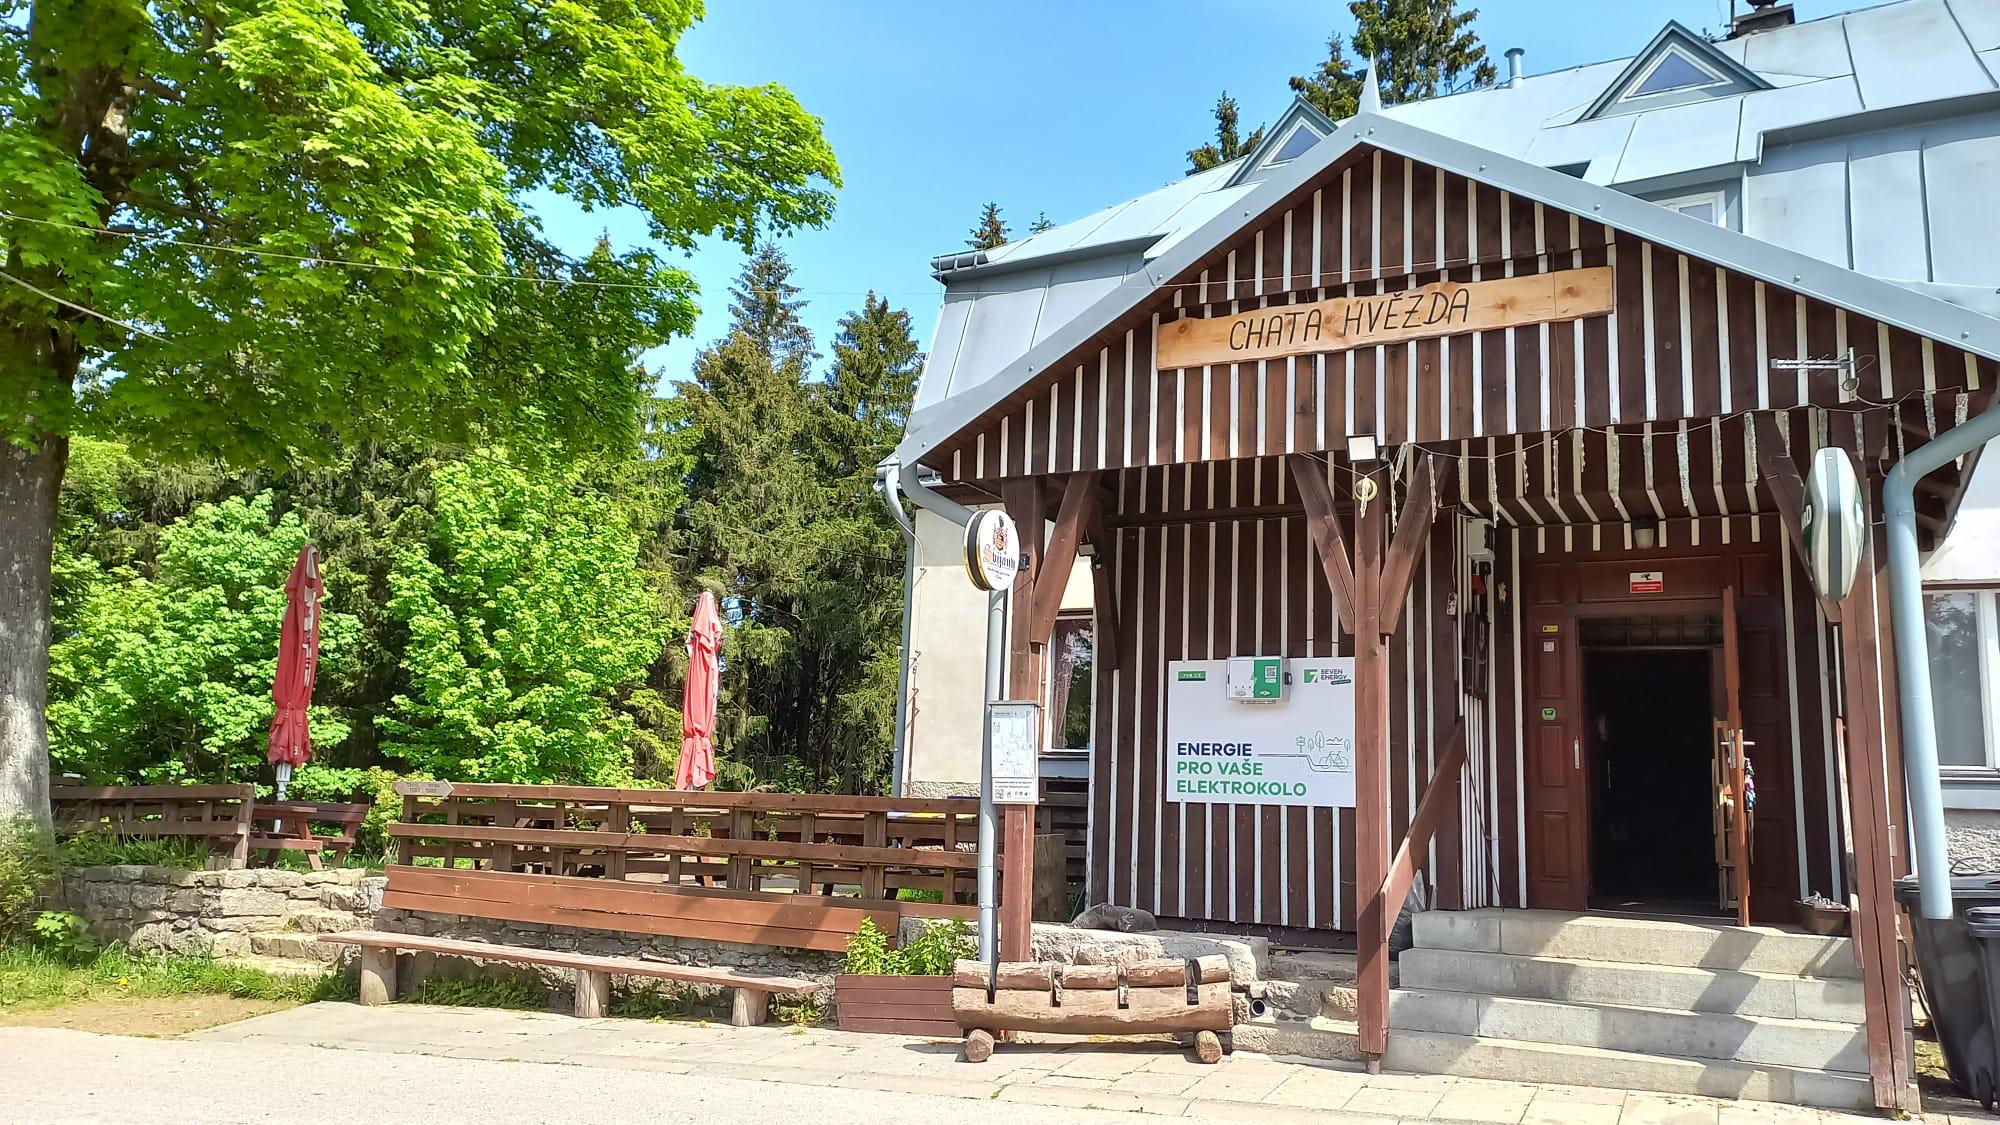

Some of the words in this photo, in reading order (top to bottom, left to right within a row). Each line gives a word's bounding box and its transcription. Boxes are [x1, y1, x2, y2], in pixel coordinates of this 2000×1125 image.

[1230, 309, 1322, 350] CHATA
[1343, 288, 1470, 336] HVĚZDA
[1177, 743, 1252, 756] ENERGIE
[1177, 761, 1212, 775] PRO
[1218, 758, 1263, 775] VAŠE
[1176, 780, 1307, 796] ELEKTROKOLO
